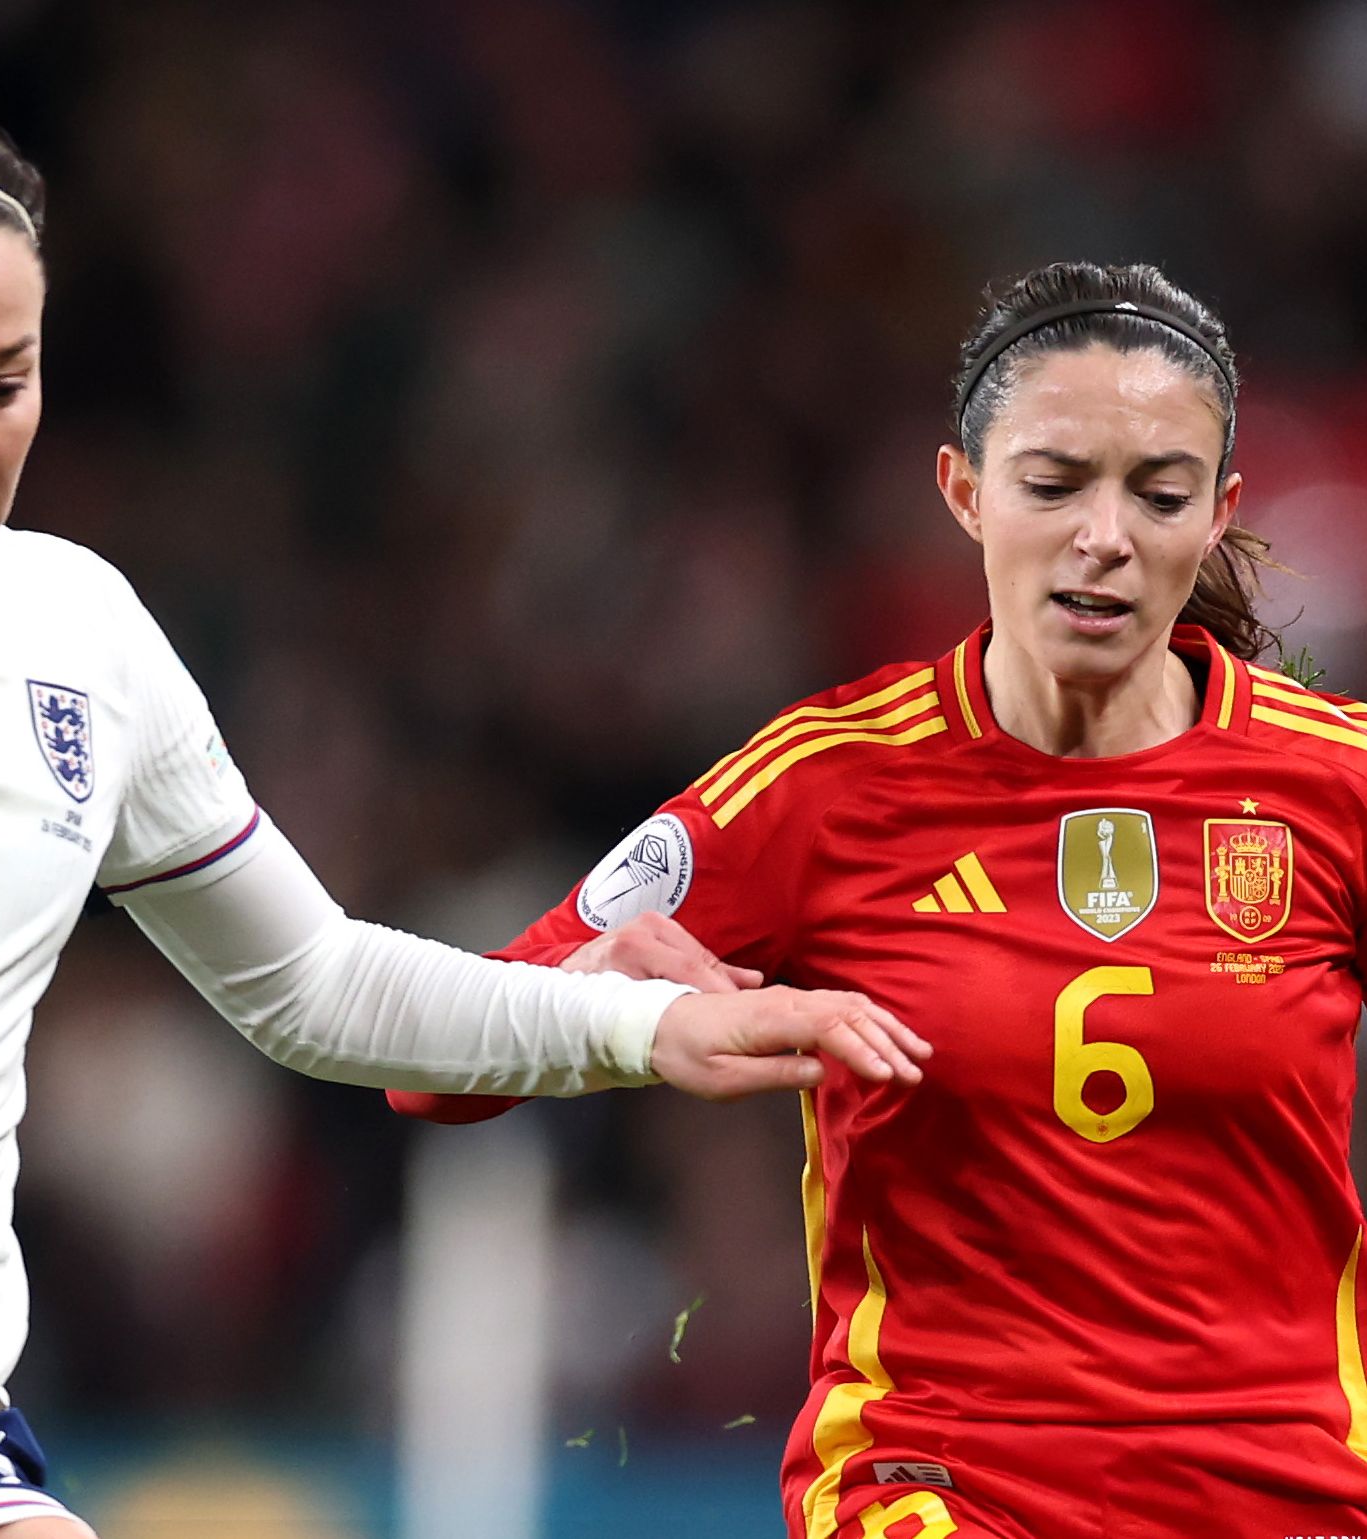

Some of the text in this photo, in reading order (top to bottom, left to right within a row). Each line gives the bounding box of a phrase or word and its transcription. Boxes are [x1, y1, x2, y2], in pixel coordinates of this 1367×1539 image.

[667, 867, 689, 906] LEAGUE
[1216, 951, 1252, 963] ENGLAND
[1224, 963, 1267, 973] FEBRUARY
[1235, 973, 1267, 985] LONDON
[1053, 965, 1155, 1144] 6
